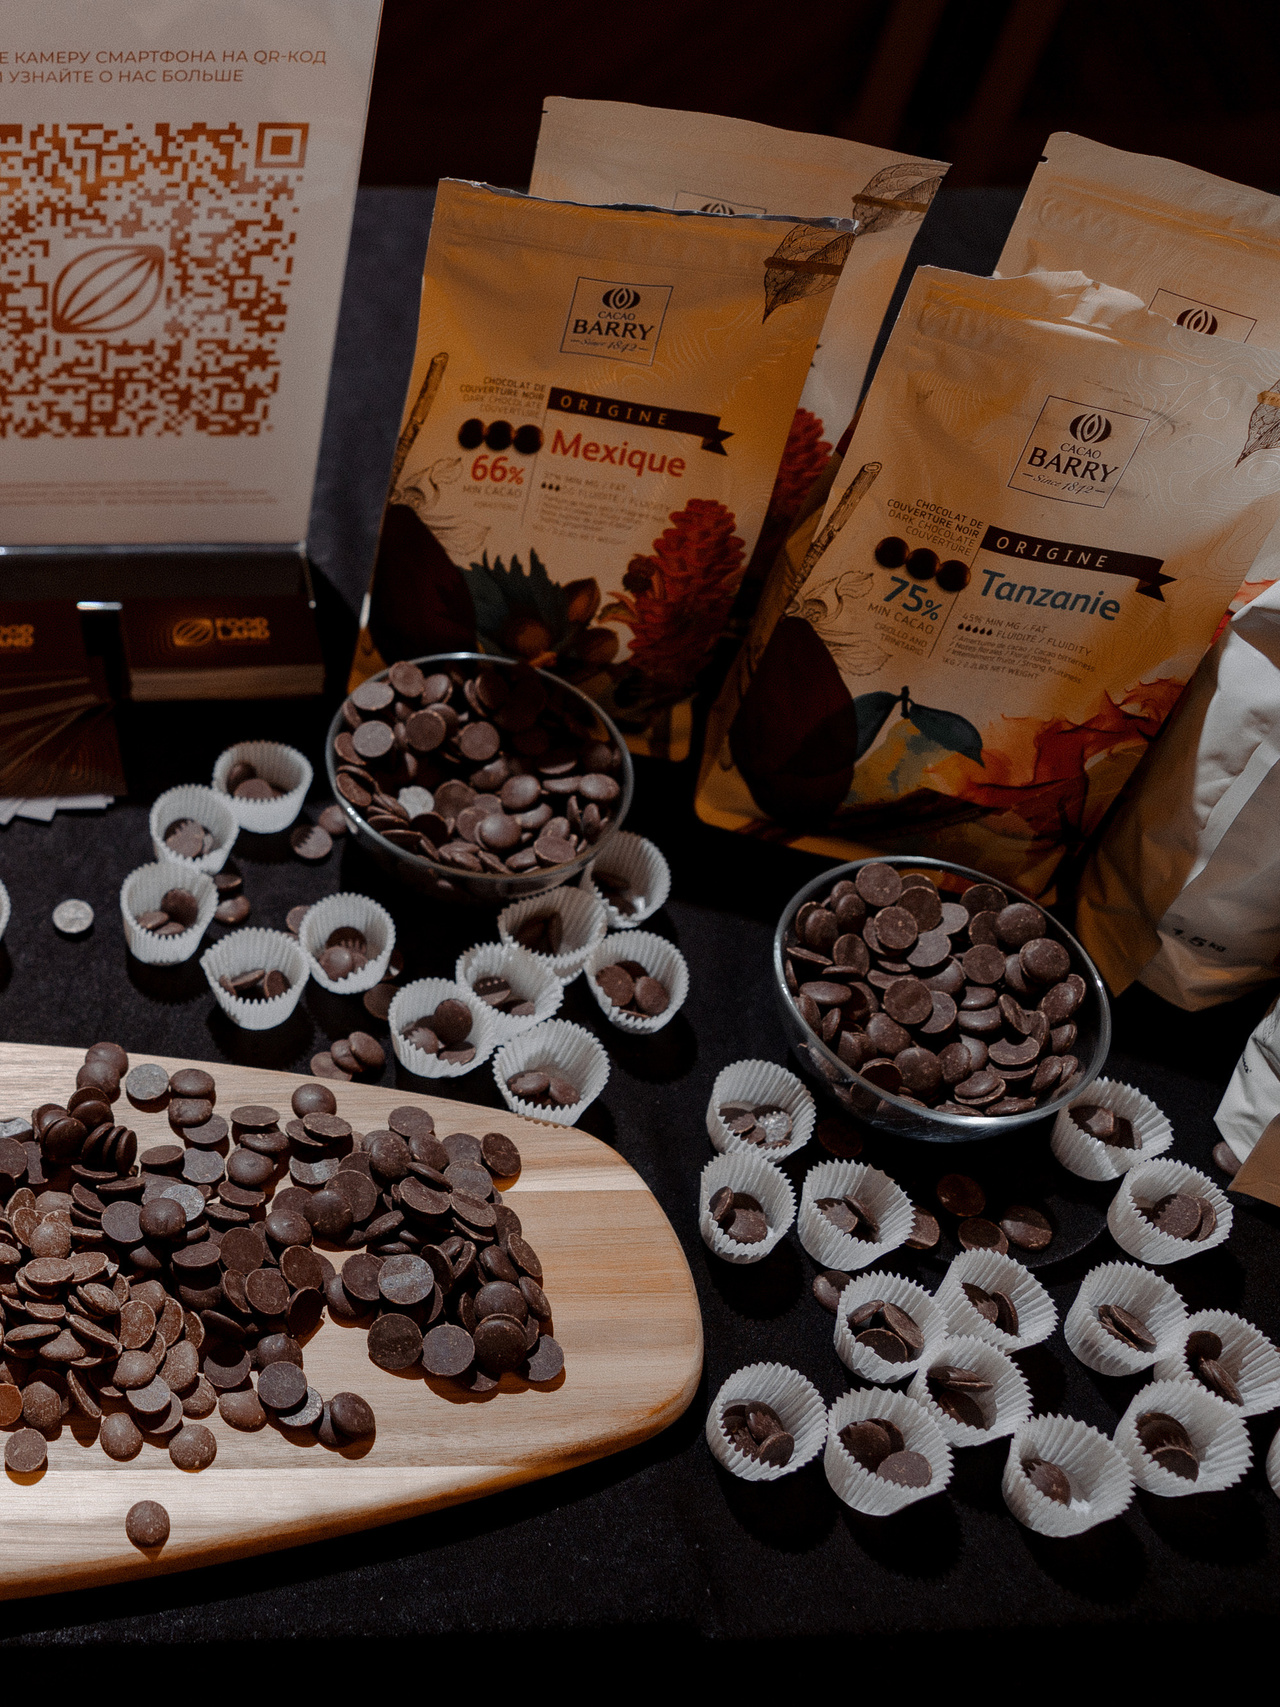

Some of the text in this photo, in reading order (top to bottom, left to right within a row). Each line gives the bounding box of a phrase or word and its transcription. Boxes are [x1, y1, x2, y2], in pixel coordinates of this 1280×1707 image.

[15, 51, 91, 64] КАМЕРУ
[96, 50, 216, 64] СМАРТФОНА
[222, 50, 248, 63] НА
[253, 50, 326, 65] QR-КОД
[9, 68, 94, 84] УЗНАЙТЕ
[99, 70, 114, 83] О
[119, 70, 157, 83] НАС
[162, 69, 244, 83] БОЛЬШЕ
[597, 310, 636, 321] CACAO
[573, 319, 655, 341] BARRY
[607, 340, 638, 353] 1842
[459, 384, 518, 397] COUVERTURE
[483, 376, 531, 389] CHOCOLAT
[560, 395, 668, 426] ORIGINE
[550, 429, 687, 478] Mexique
[1027, 446, 1119, 483] BARRY
[1060, 442, 1102, 459] CACAO
[471, 454, 525, 485] 66%
[1033, 474, 1094, 495] Since 1842
[887, 498, 980, 539] COUVERTURE NOIR
[888, 509, 976, 548] DARK CHOCOLATE
[916, 499, 984, 530] CHOCOLAT DE
[905, 525, 972, 557] COUVERTURE
[996, 536, 1108, 568] ORIGINE
[883, 575, 943, 621] 75%
[980, 568, 1121, 621] Tanzanie
[867, 603, 935, 635] MIN CACAO
[962, 612, 983, 624] 45%
[985, 617, 1003, 628] MIN
[1005, 621, 1021, 631] MG
[1029, 624, 1048, 635] FAT
[995, 629, 1038, 644] FLUIDITÉ
[1046, 637, 1092, 657] FLUIDITY
[1033, 647, 1056, 659] Cacao
[1021, 660, 1046, 673] Strong
